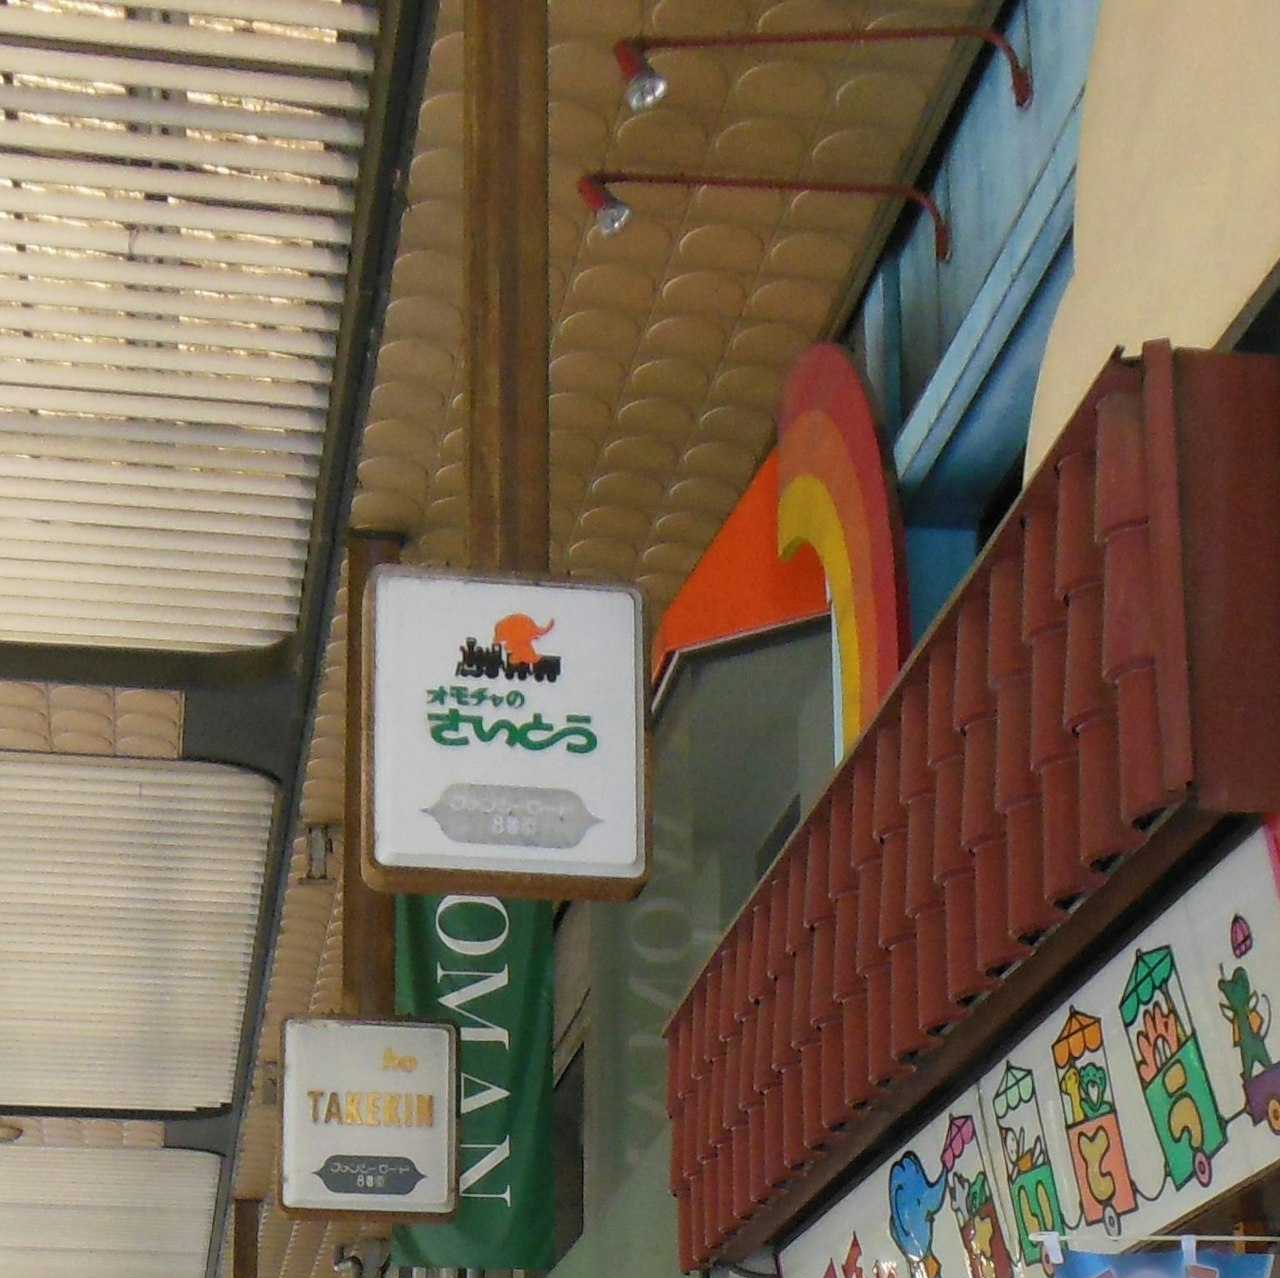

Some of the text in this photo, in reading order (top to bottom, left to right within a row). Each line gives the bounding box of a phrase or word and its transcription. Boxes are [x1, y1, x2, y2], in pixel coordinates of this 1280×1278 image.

[426, 685, 525, 708] オモチャの
[426, 708, 598, 754] さいとう
[307, 1090, 434, 1127] TAKEKIN
